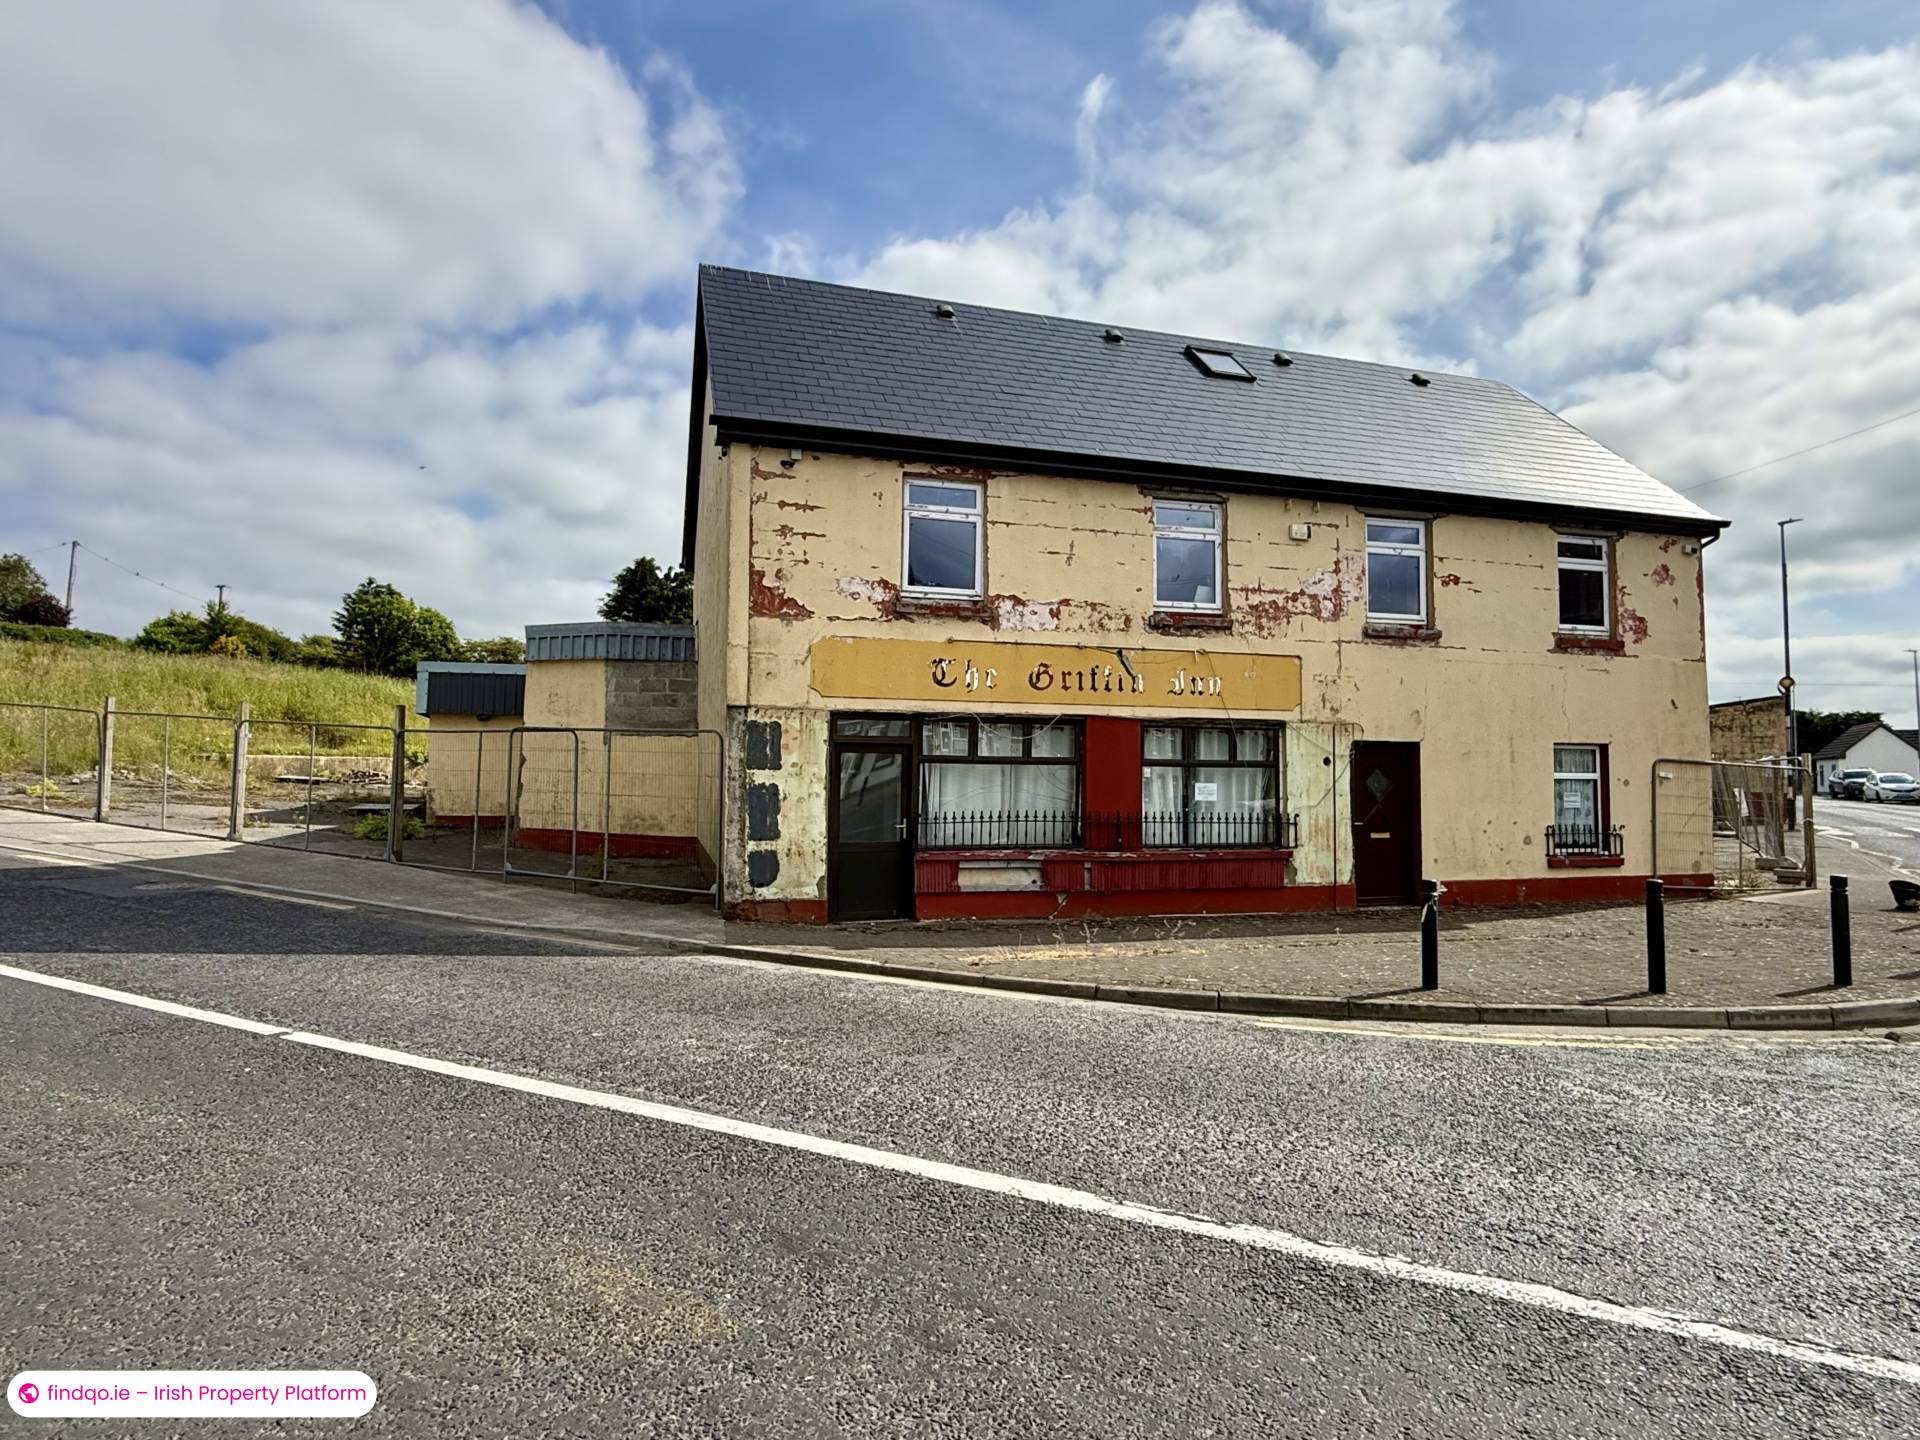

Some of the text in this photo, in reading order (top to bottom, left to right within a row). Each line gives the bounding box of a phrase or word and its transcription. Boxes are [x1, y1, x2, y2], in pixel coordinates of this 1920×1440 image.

[929, 657, 1222, 697] The Griffin Inn
